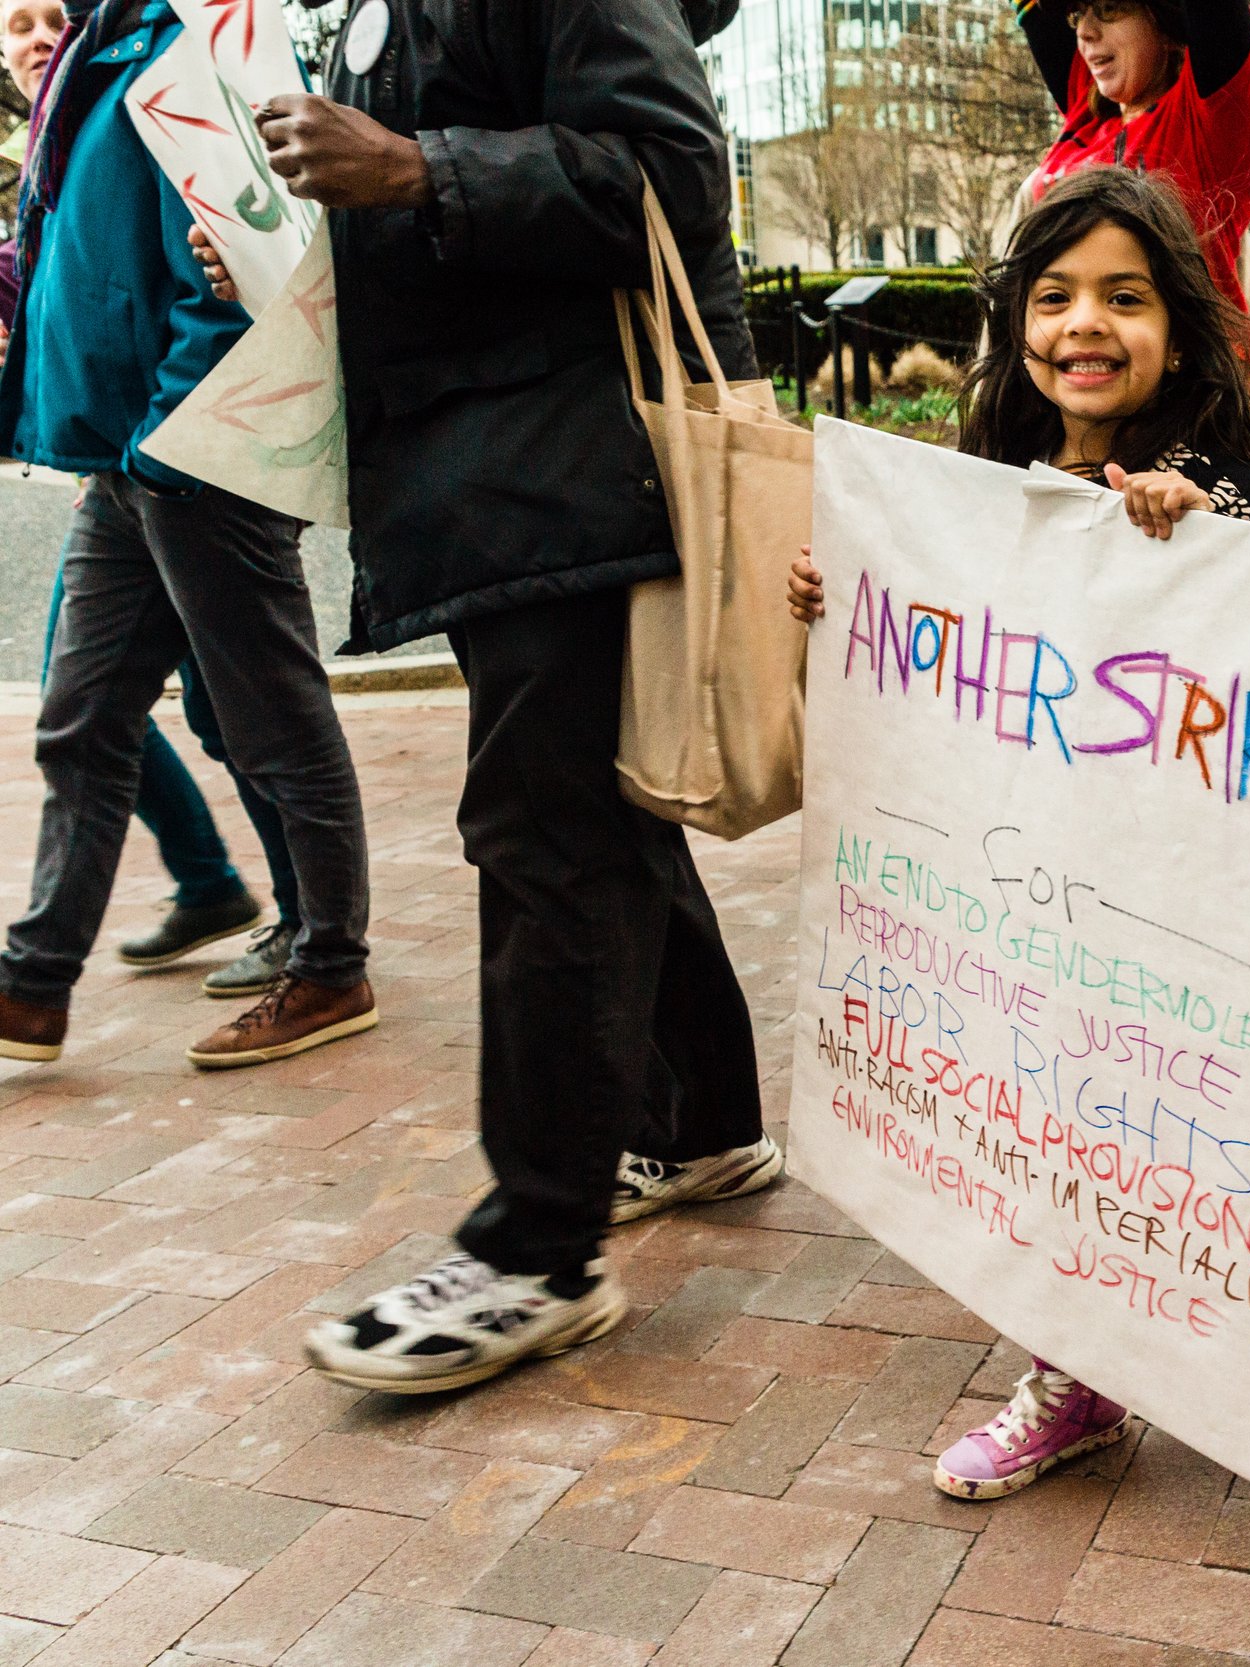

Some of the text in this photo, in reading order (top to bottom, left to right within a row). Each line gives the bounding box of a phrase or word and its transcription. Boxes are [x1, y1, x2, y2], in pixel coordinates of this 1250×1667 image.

[846, 570, 1077, 764] ANOTHER
[818, 927, 969, 1065] LABOR
[835, 826, 870, 884] AN
[879, 844, 947, 912] END
[996, 912, 1168, 1018] GENDER
[840, 884, 1241, 1109] REPRODUCTIVE JUSTICE
[844, 994, 914, 1072] FULL
[922, 1047, 1037, 1146] SOCIAL
[832, 1085, 1228, 1338] ENVIRONMENTAL JUSTICE
